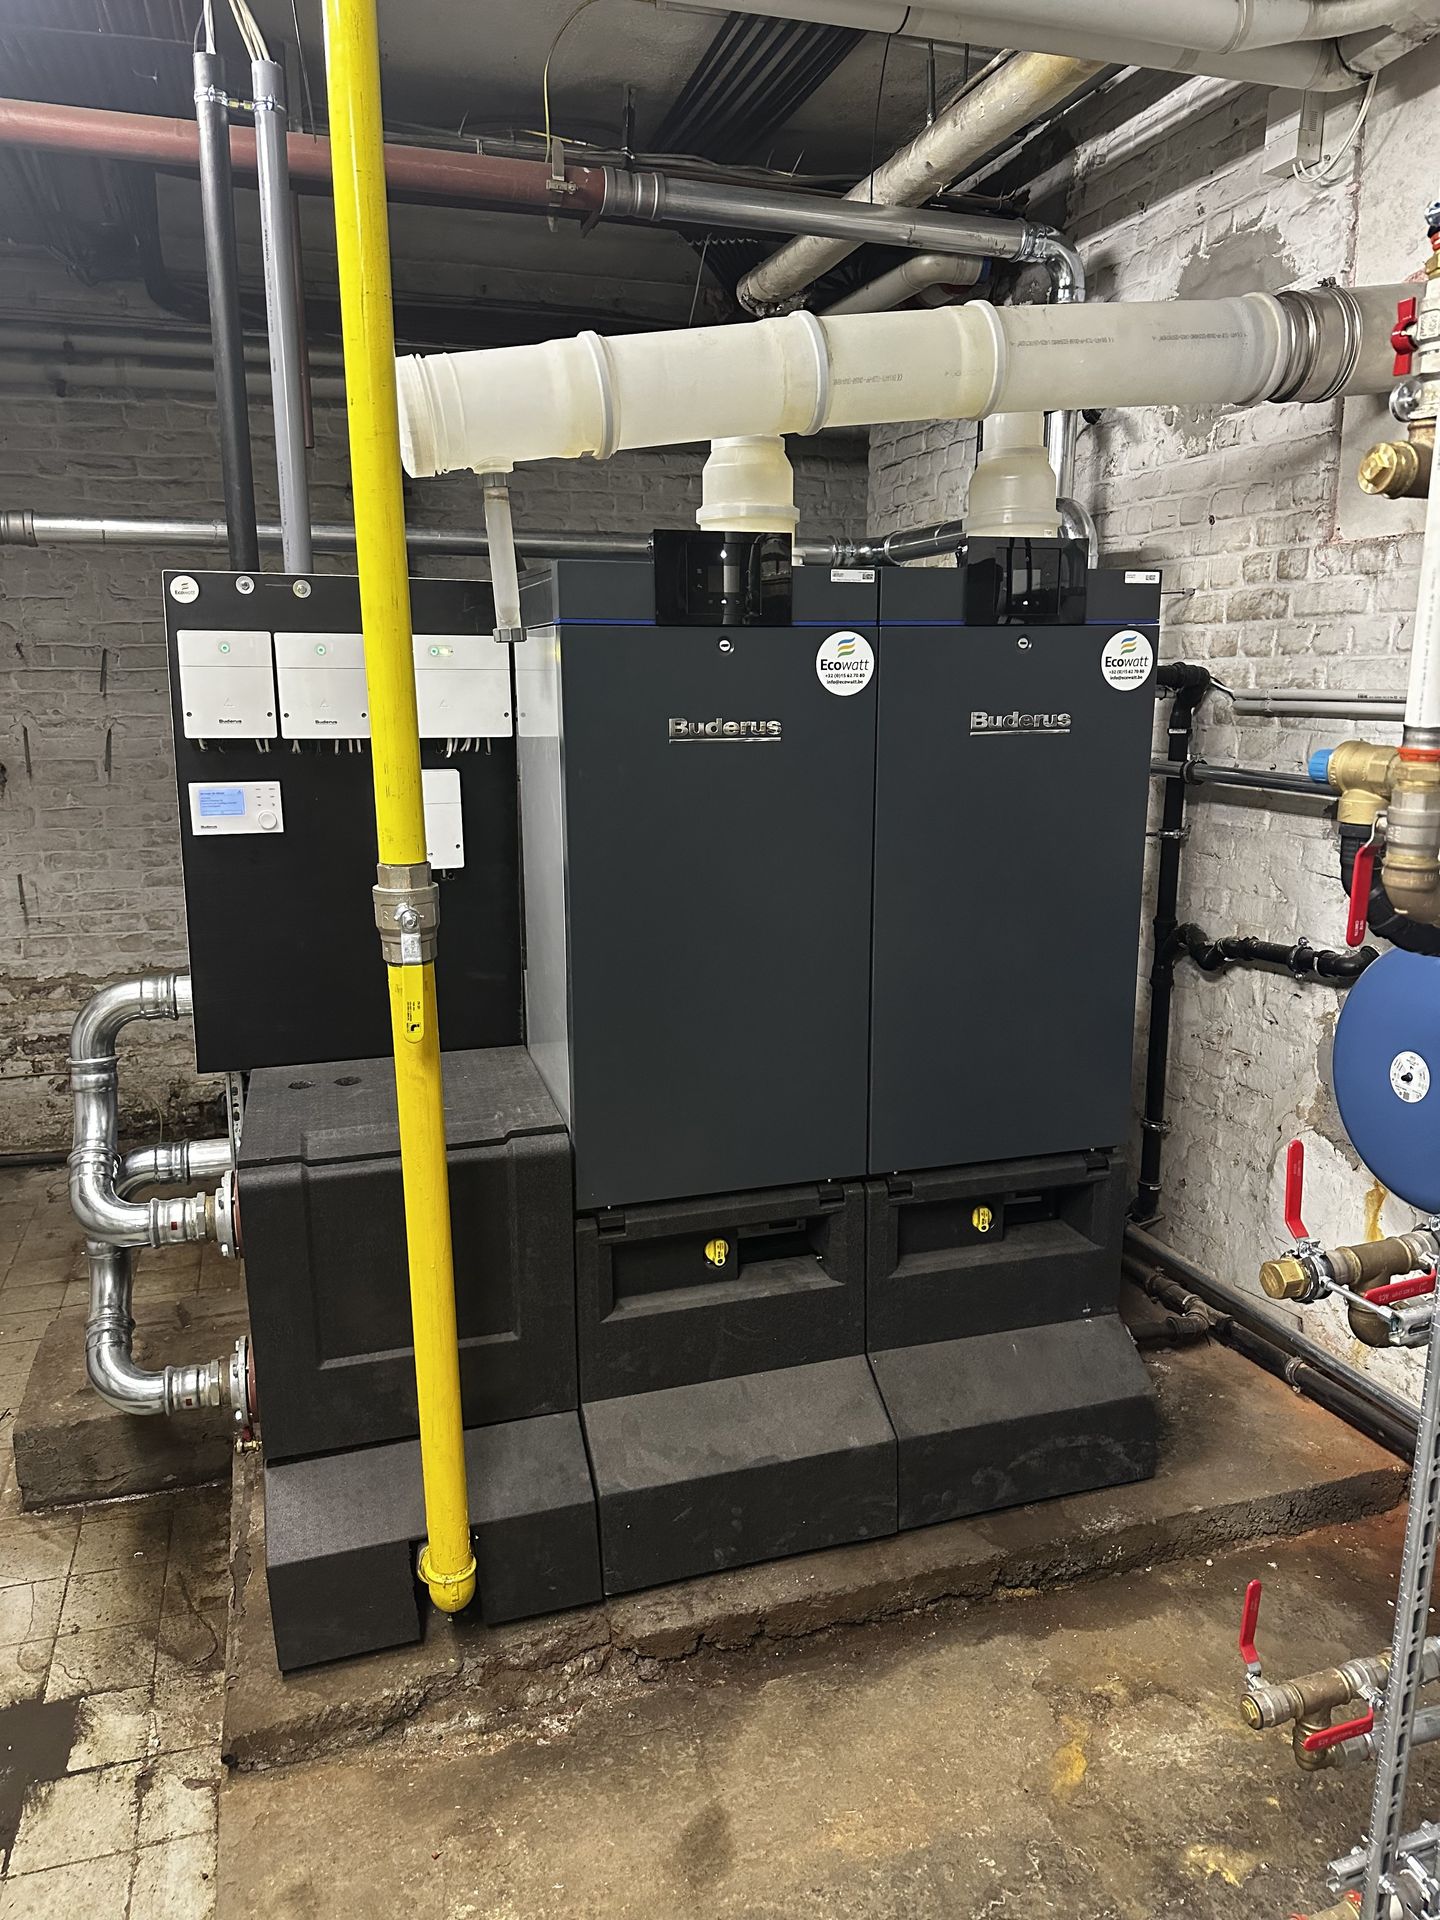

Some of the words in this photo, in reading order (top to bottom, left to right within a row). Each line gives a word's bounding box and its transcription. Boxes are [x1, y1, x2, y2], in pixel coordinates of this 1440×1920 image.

[820, 658, 870, 671] Ecowatt
[1105, 656, 1149, 667] Ecowatt
[669, 718, 782, 737] Buderus
[970, 711, 1072, 730] Buderus
